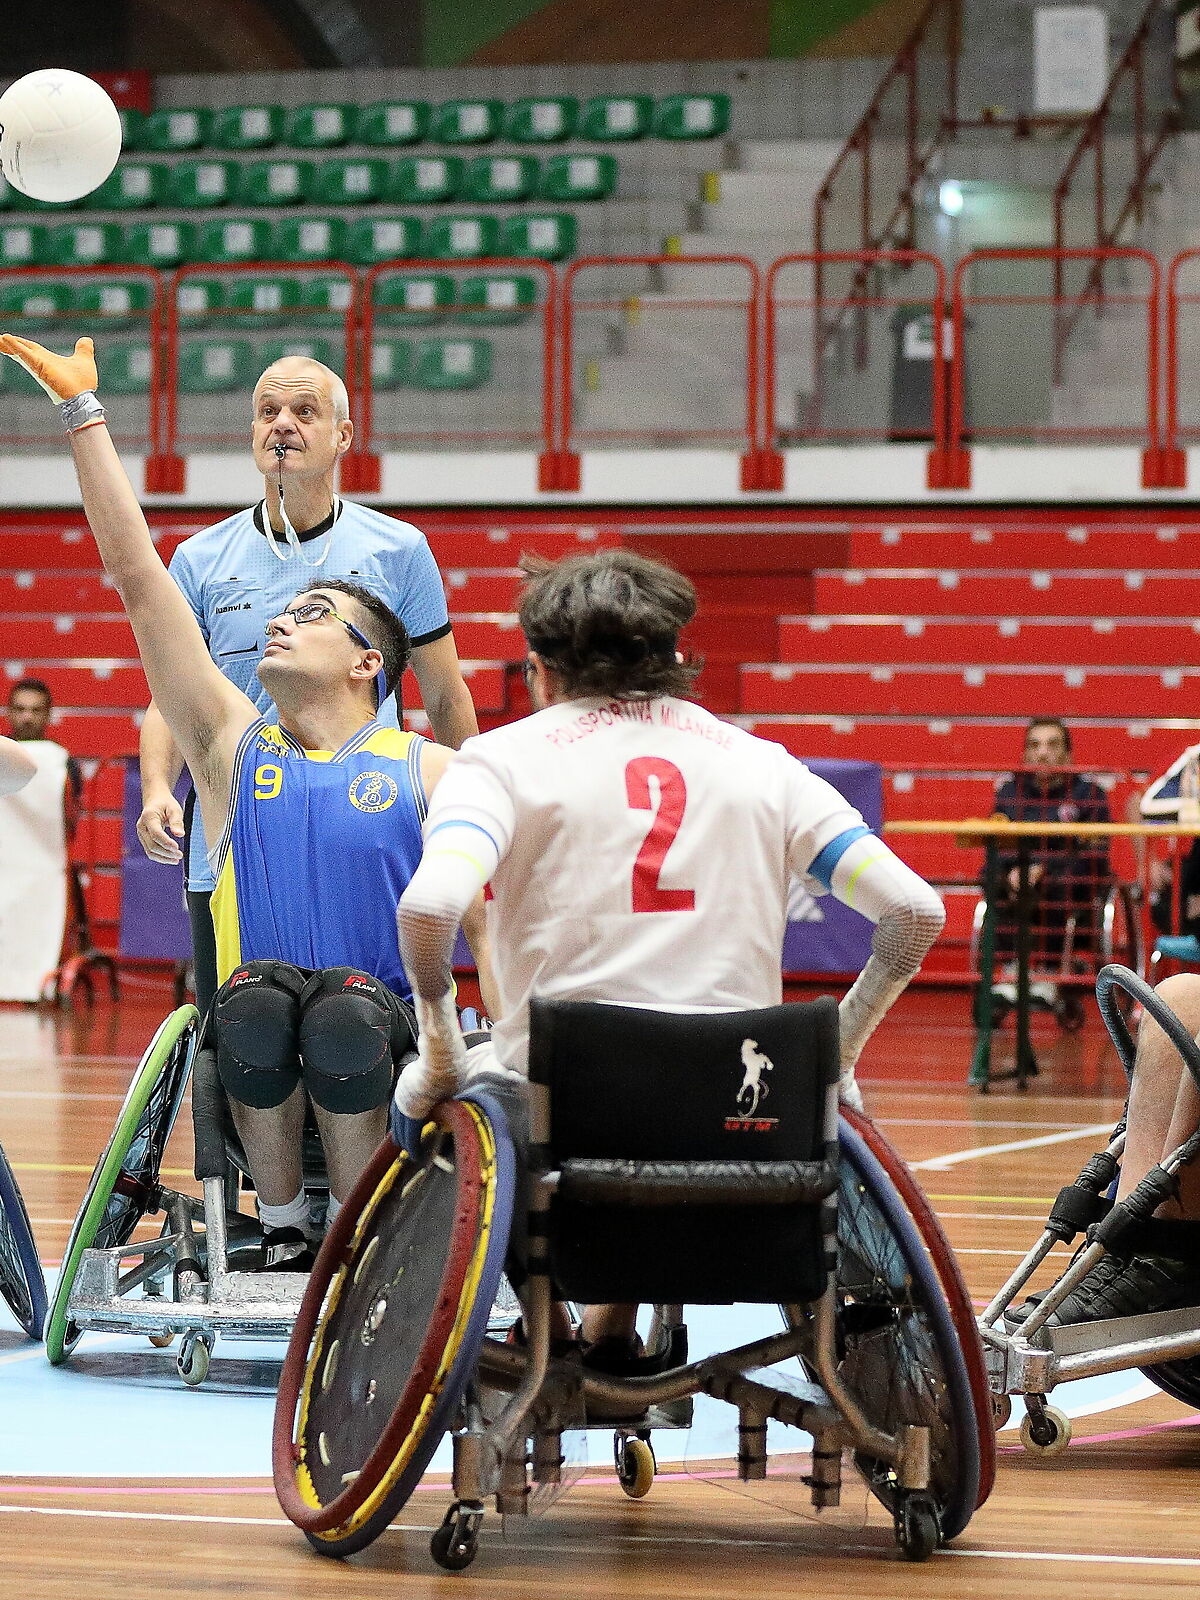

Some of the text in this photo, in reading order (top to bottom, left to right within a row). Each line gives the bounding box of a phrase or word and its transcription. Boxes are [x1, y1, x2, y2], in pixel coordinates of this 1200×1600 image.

[545, 701, 735, 750] POLISPORTIVA MILANESE
[254, 763, 283, 800] 9
[625, 756, 696, 913] 2
